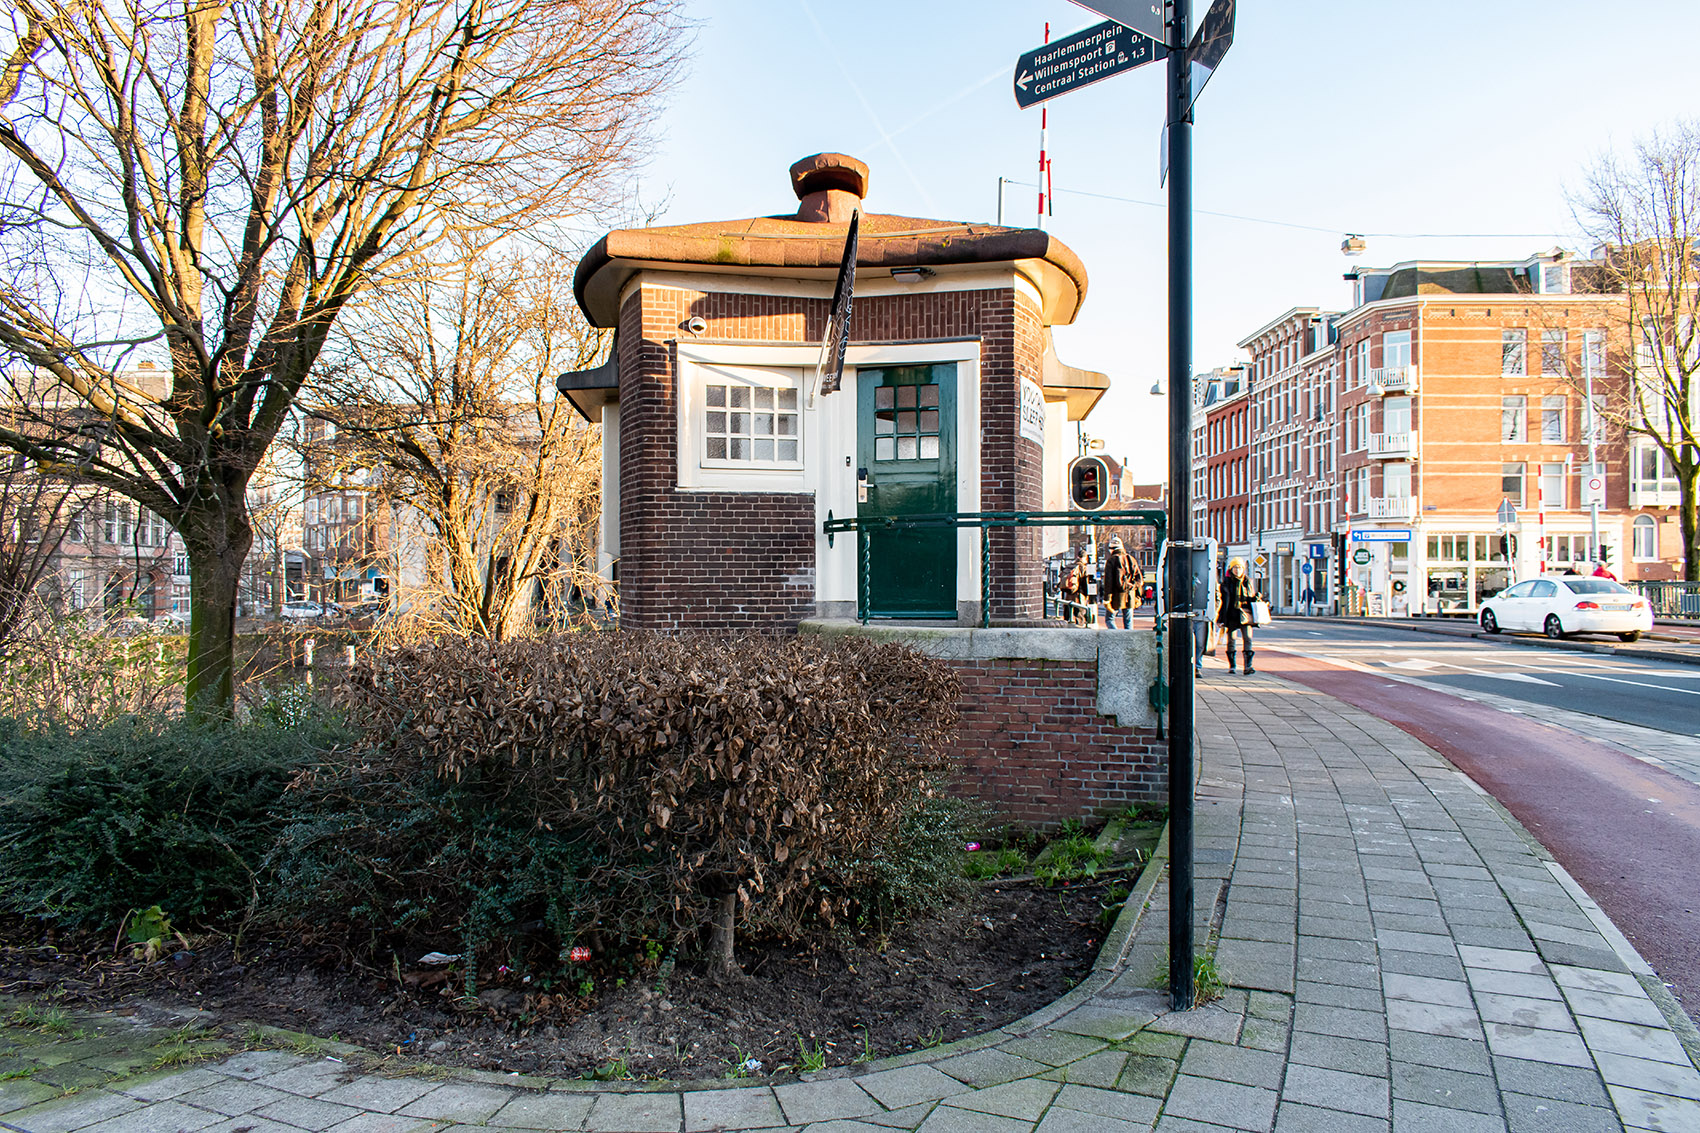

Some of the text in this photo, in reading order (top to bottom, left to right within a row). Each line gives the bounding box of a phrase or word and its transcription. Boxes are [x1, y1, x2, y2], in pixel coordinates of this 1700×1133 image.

[1034, 25, 1123, 67] Haarlemmerplein
[1034, 47, 1102, 81] Willemspoort
[1034, 47, 1146, 95] Centraal Station 1,3
[1312, 546, 1321, 557] L
